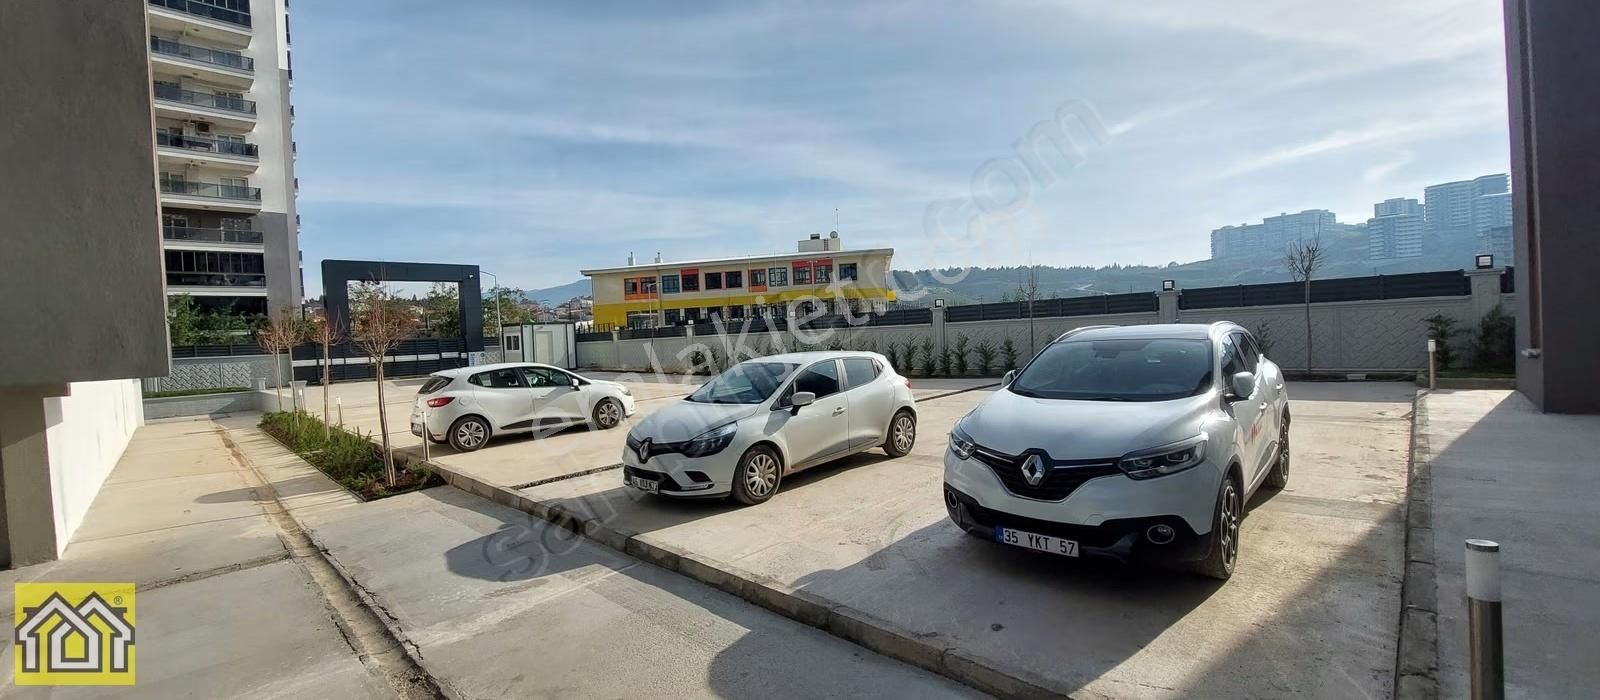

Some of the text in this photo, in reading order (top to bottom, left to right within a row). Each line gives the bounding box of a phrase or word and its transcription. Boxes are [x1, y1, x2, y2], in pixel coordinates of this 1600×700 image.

[1004, 530, 1019, 544] 35
[1028, 534, 1050, 551] YKT
[1060, 540, 1076, 555] 57
